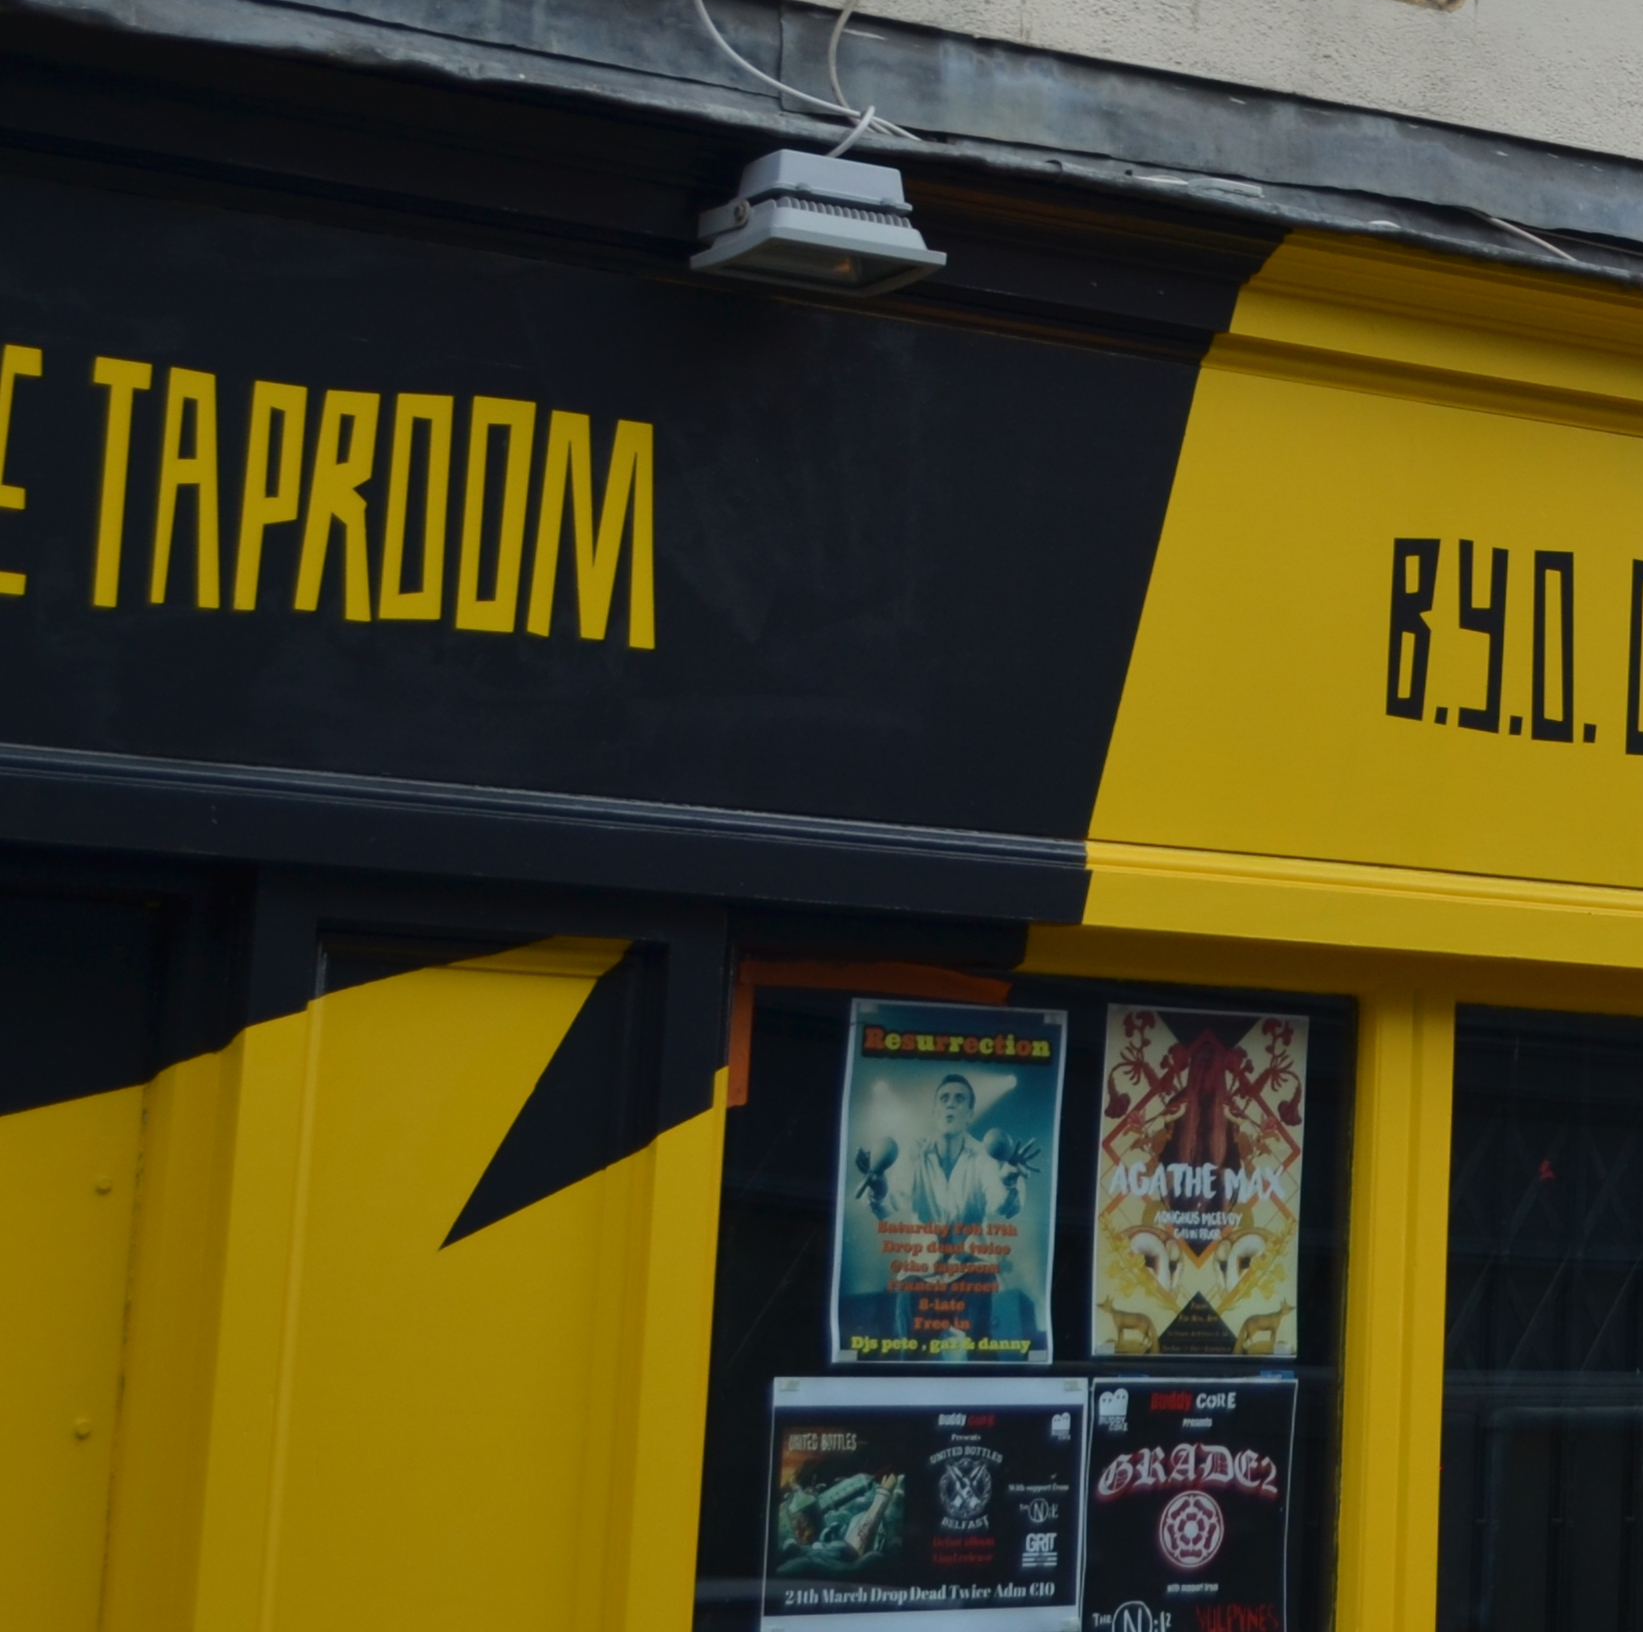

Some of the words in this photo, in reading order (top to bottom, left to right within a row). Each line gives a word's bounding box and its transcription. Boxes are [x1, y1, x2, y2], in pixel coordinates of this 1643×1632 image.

[94, 356, 656, 650] TAPROOM
[1386, 537, 1597, 743] B.Y.O.
[863, 1025, 1051, 1058] Resurrection
[1110, 1160, 1219, 1200] AGATHE
[1223, 1161, 1286, 1204] MAX
[877, 1221, 950, 1238] Saturday
[954, 1222, 982, 1235] Feb
[882, 1240, 922, 1256] Drop
[927, 1241, 964, 1255] dead
[969, 1242, 1011, 1255] twice
[887, 1278, 948, 1292] Francis
[951, 1279, 999, 1293] street
[914, 1317, 950, 1330] Free
[954, 1317, 971, 1330] in
[851, 1336, 878, 1354] Djs
[881, 1337, 918, 1353] pete
[978, 1336, 1031, 1354] danny
[788, 1434, 818, 1451] UNITED
[820, 1433, 858, 1451] BOTTLES
[930, 1446, 963, 1464] UNITED
[964, 1446, 1004, 1464] BOTTLES
[941, 1514, 990, 1530] BELFAST
[1025, 1532, 1058, 1552] GRIT
[785, 1586, 819, 1606] 24th
[822, 1585, 868, 1605] March
[870, 1585, 908, 1606] Drop
[909, 1584, 946, 1601] Dead
[948, 1582, 992, 1600] Twice
[994, 1581, 1027, 1599] Adm
[1029, 1580, 1055, 1598] €10
